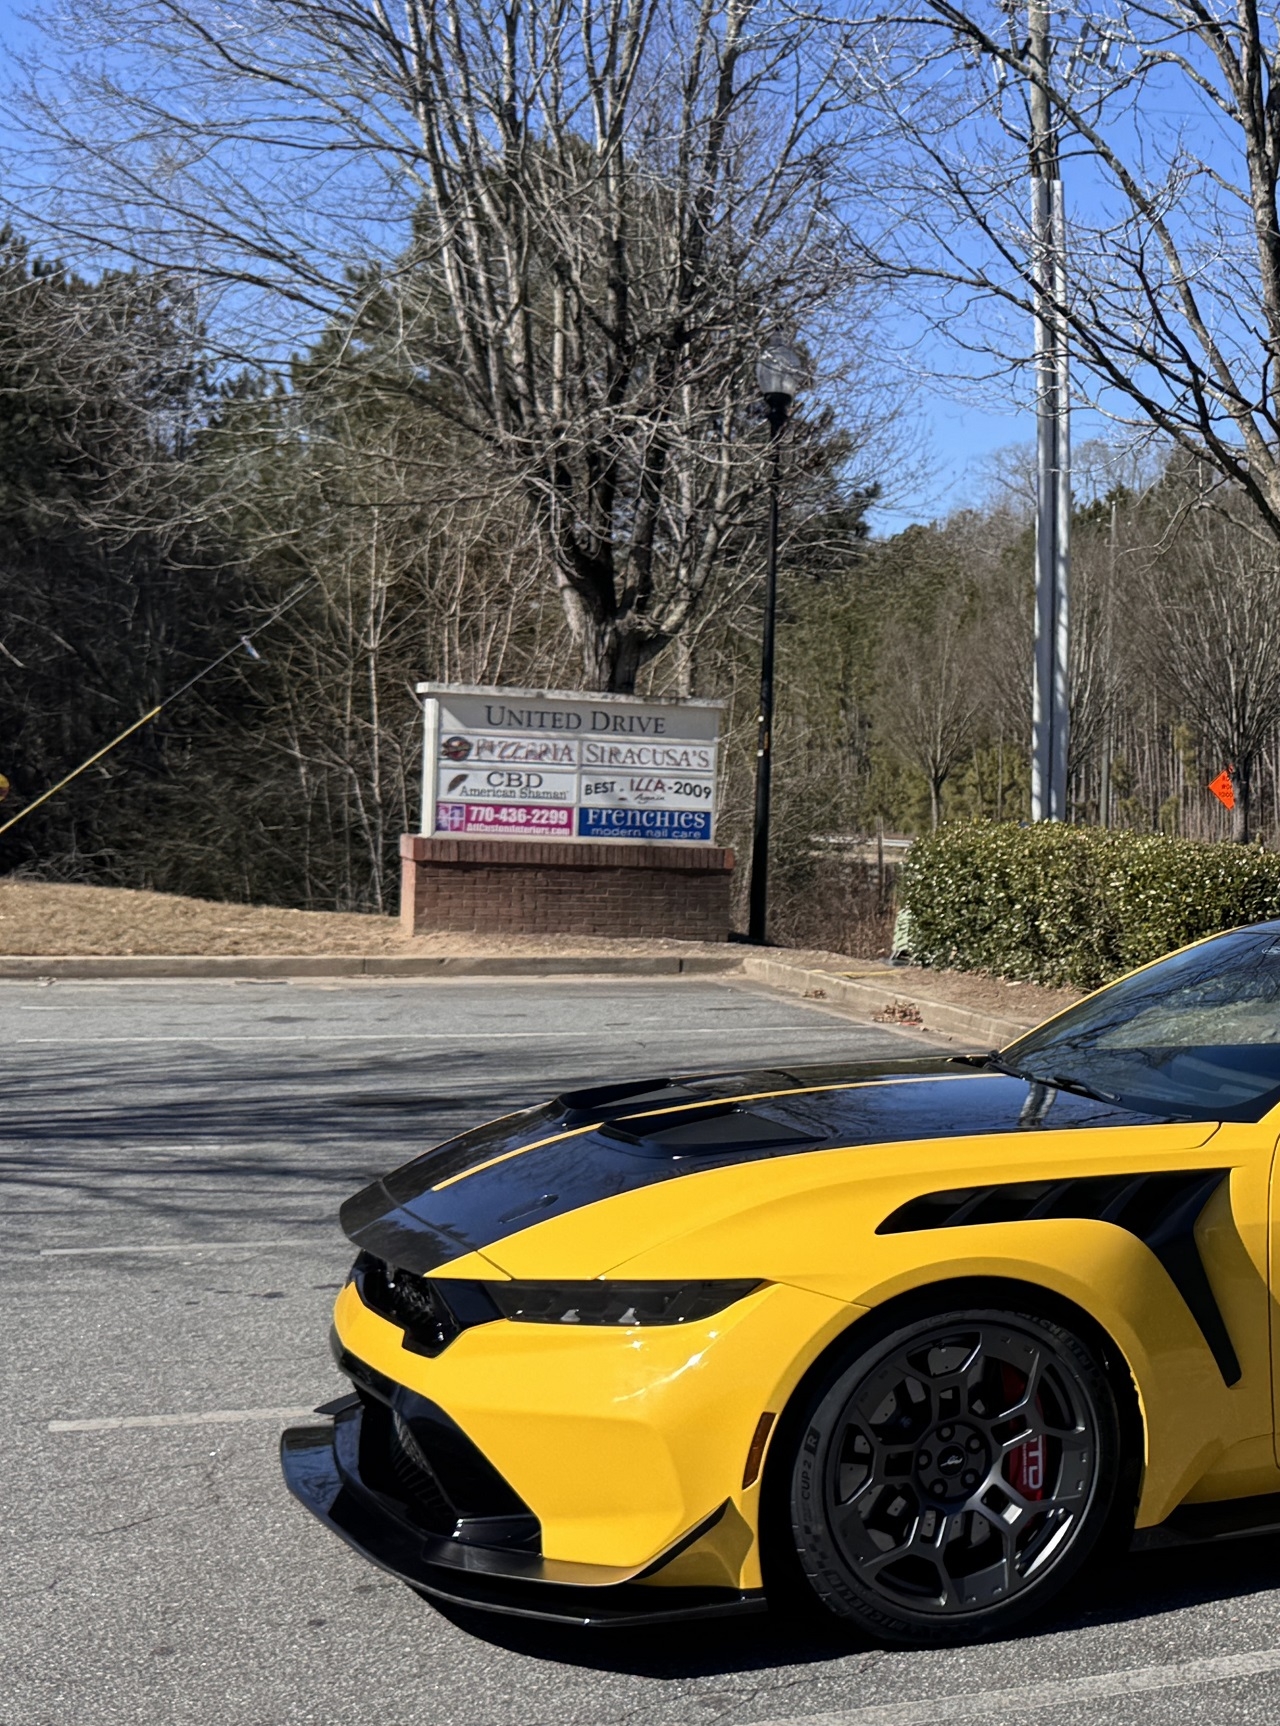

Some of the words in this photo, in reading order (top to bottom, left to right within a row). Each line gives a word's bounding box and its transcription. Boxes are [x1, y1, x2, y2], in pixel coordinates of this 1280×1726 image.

[485, 705, 582, 730] UNITED
[591, 710, 666, 734] DRIVE
[586, 743, 710, 768] SIRACUSA'S
[486, 771, 543, 788] CBD
[460, 785, 516, 799] American
[519, 787, 567, 800] Shaman
[584, 781, 616, 796] BEST
[469, 806, 569, 825] 770-436-2299
[590, 826, 641, 837] modern
[645, 828, 668, 838] nail
[672, 830, 702, 839] care
[806, 1433, 818, 1449] R
[803, 1460, 812, 1470] 2
[1028, 1435, 1043, 1489] TD
[801, 1471, 811, 1500] CUP
